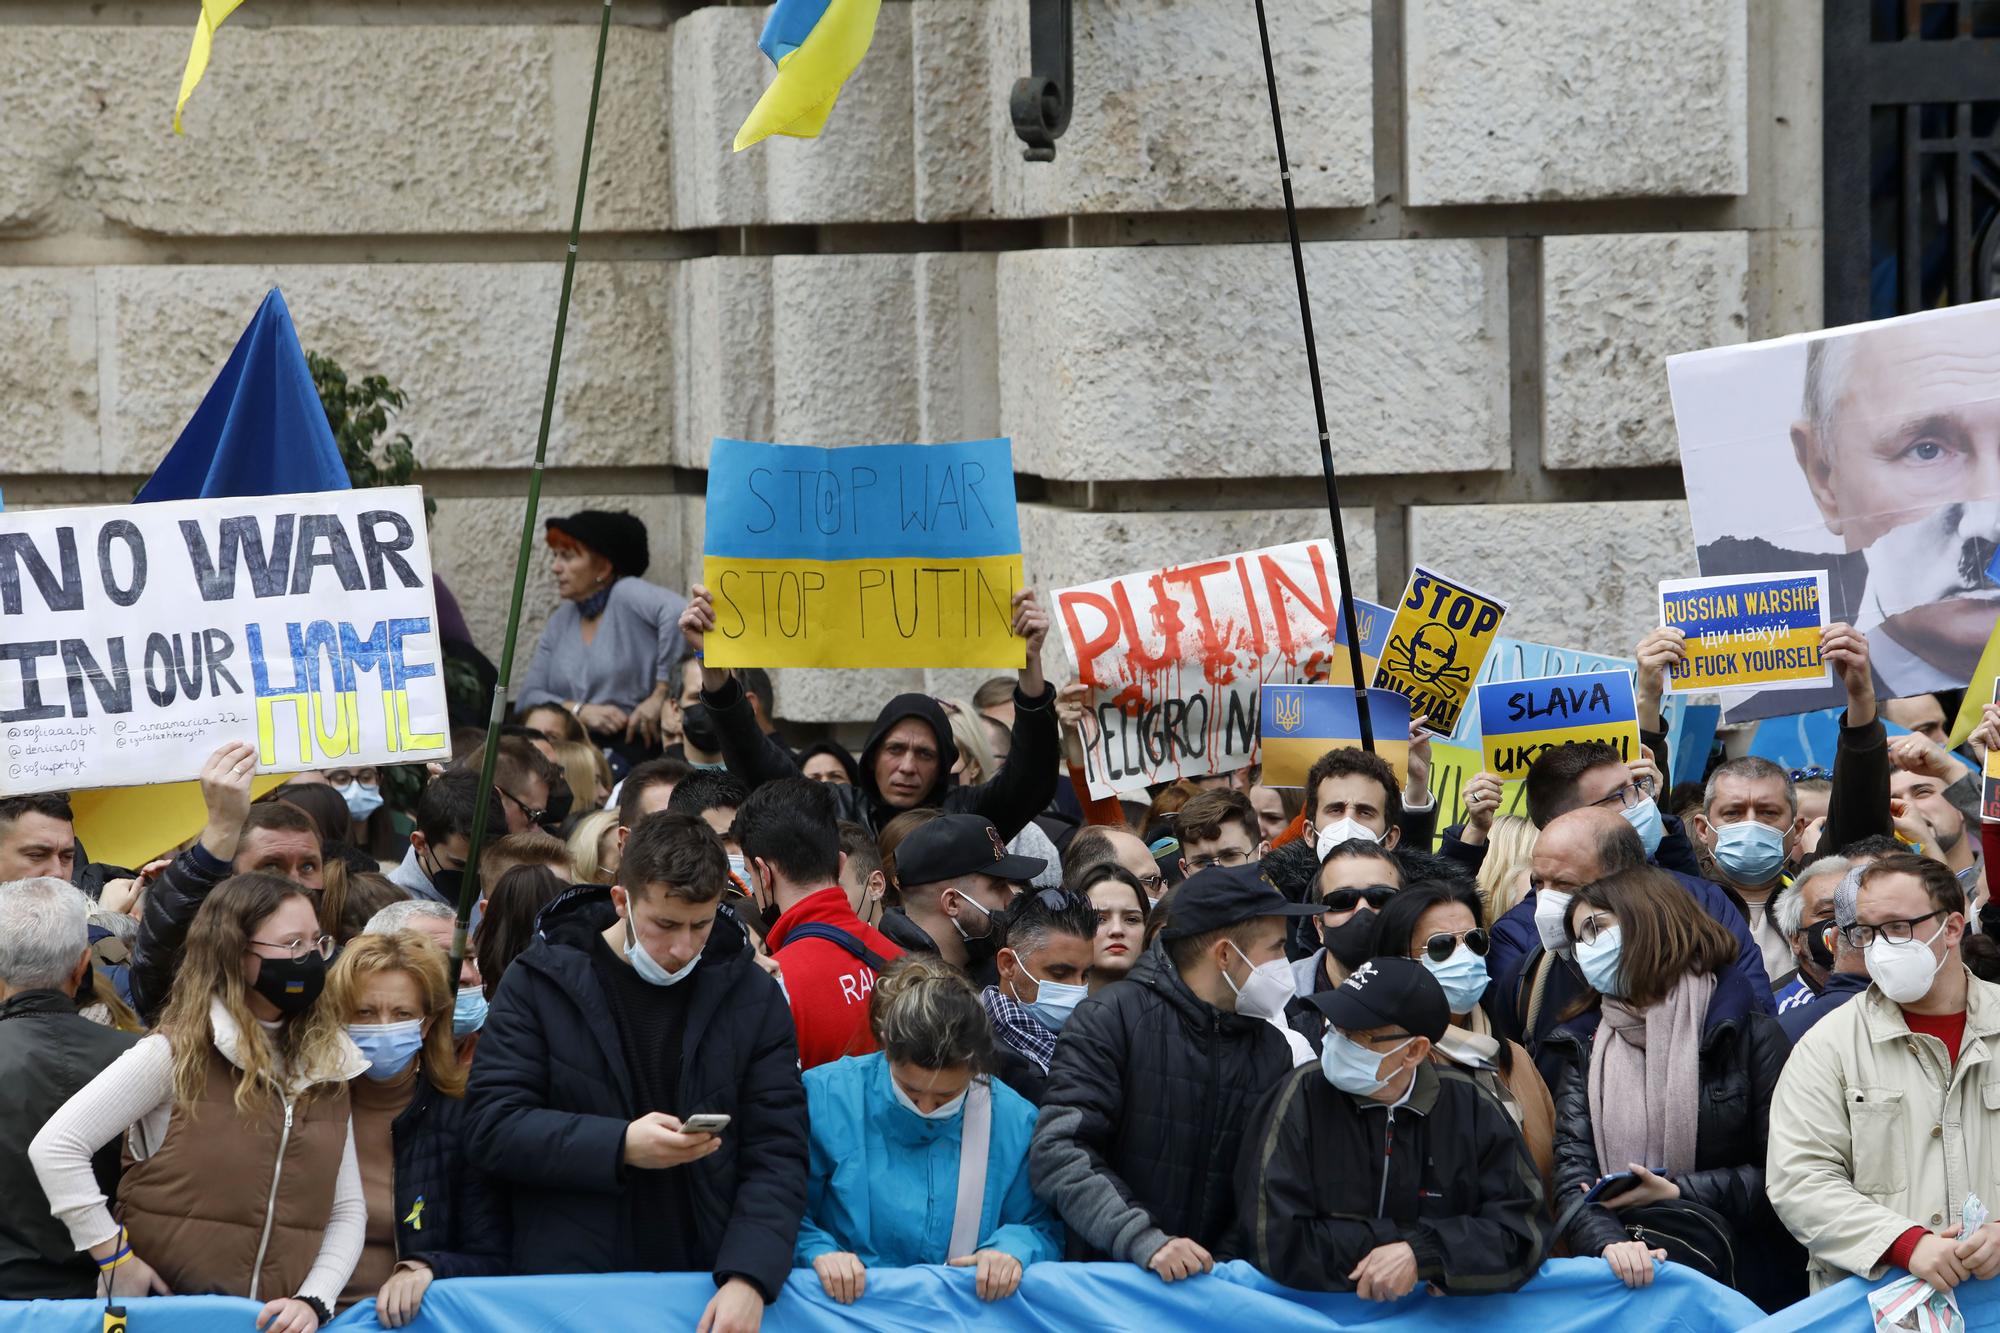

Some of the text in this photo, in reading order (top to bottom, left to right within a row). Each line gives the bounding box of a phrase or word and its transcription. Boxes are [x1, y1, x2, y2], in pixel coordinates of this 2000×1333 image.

[747, 462, 994, 535] STOP WAR
[0, 510, 424, 614] NO WAR
[720, 566, 1013, 638] STOP PUTIN
[1059, 545, 1337, 687] PUTIN
[1406, 577, 1498, 637] STOP
[1665, 586, 1819, 624] RUSSIAN WARSHIP
[1734, 619, 1790, 645] нахуй
[0, 617, 446, 766] IN OUR HOME
[1696, 652, 1741, 677] FUCK
[1742, 646, 1823, 673] YOURSELF
[1080, 693, 1208, 782] PELIGRO
[1508, 683, 1610, 721] SLAVA
